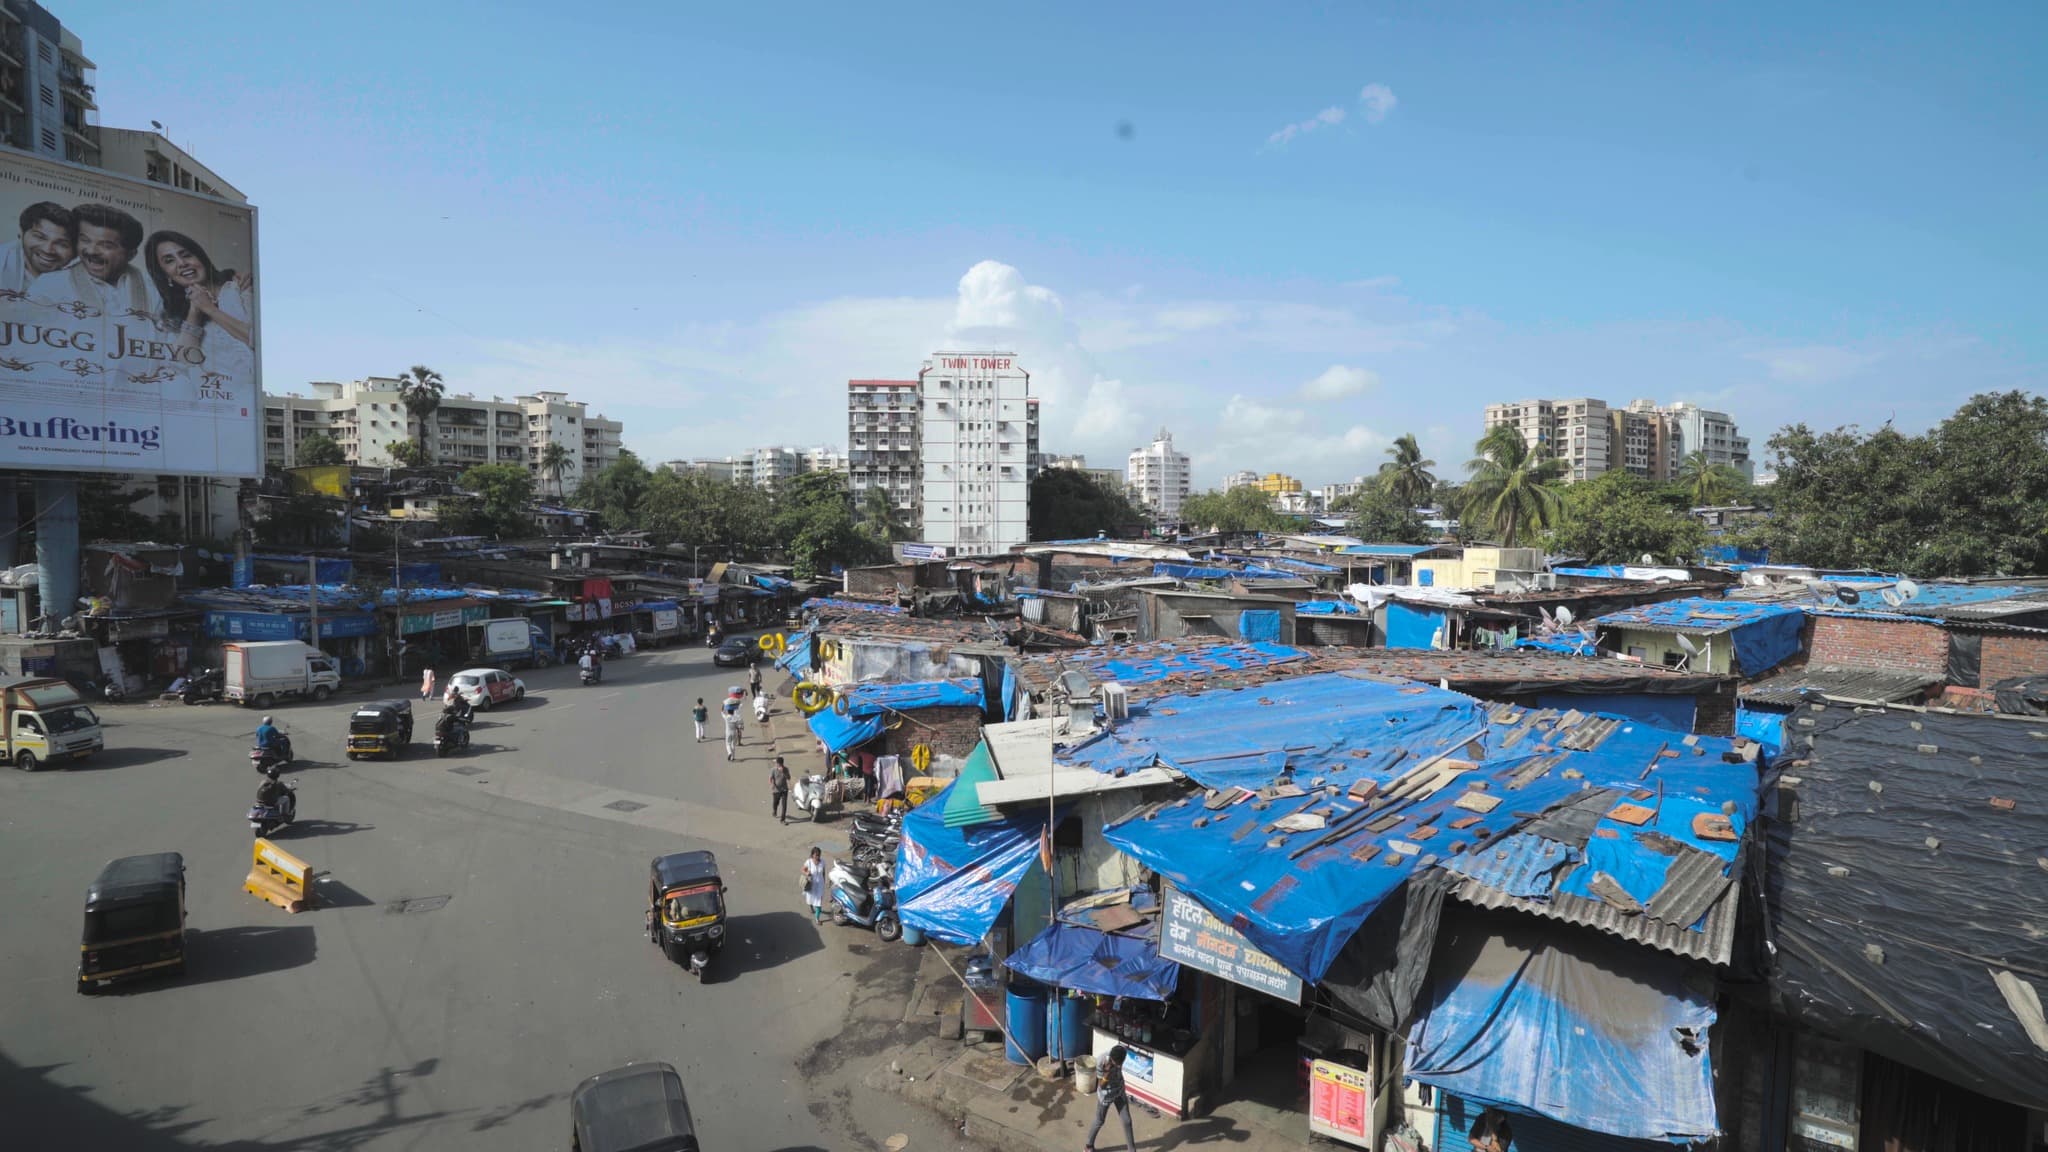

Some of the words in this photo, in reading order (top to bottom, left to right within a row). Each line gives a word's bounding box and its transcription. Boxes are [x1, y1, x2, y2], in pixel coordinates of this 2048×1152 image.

[24, 177, 75, 195] reunion,
[79, 188, 98, 200] full
[101, 193, 112, 204] of
[0, 321, 97, 352] JUGG
[107, 323, 206, 365] JEEYO
[941, 358, 968, 370] TWIN
[973, 358, 1011, 370] TOWER
[199, 389, 234, 401] JUNE
[0, 416, 160, 450] Buffering
[1171, 895, 1204, 924] हॉटेल
